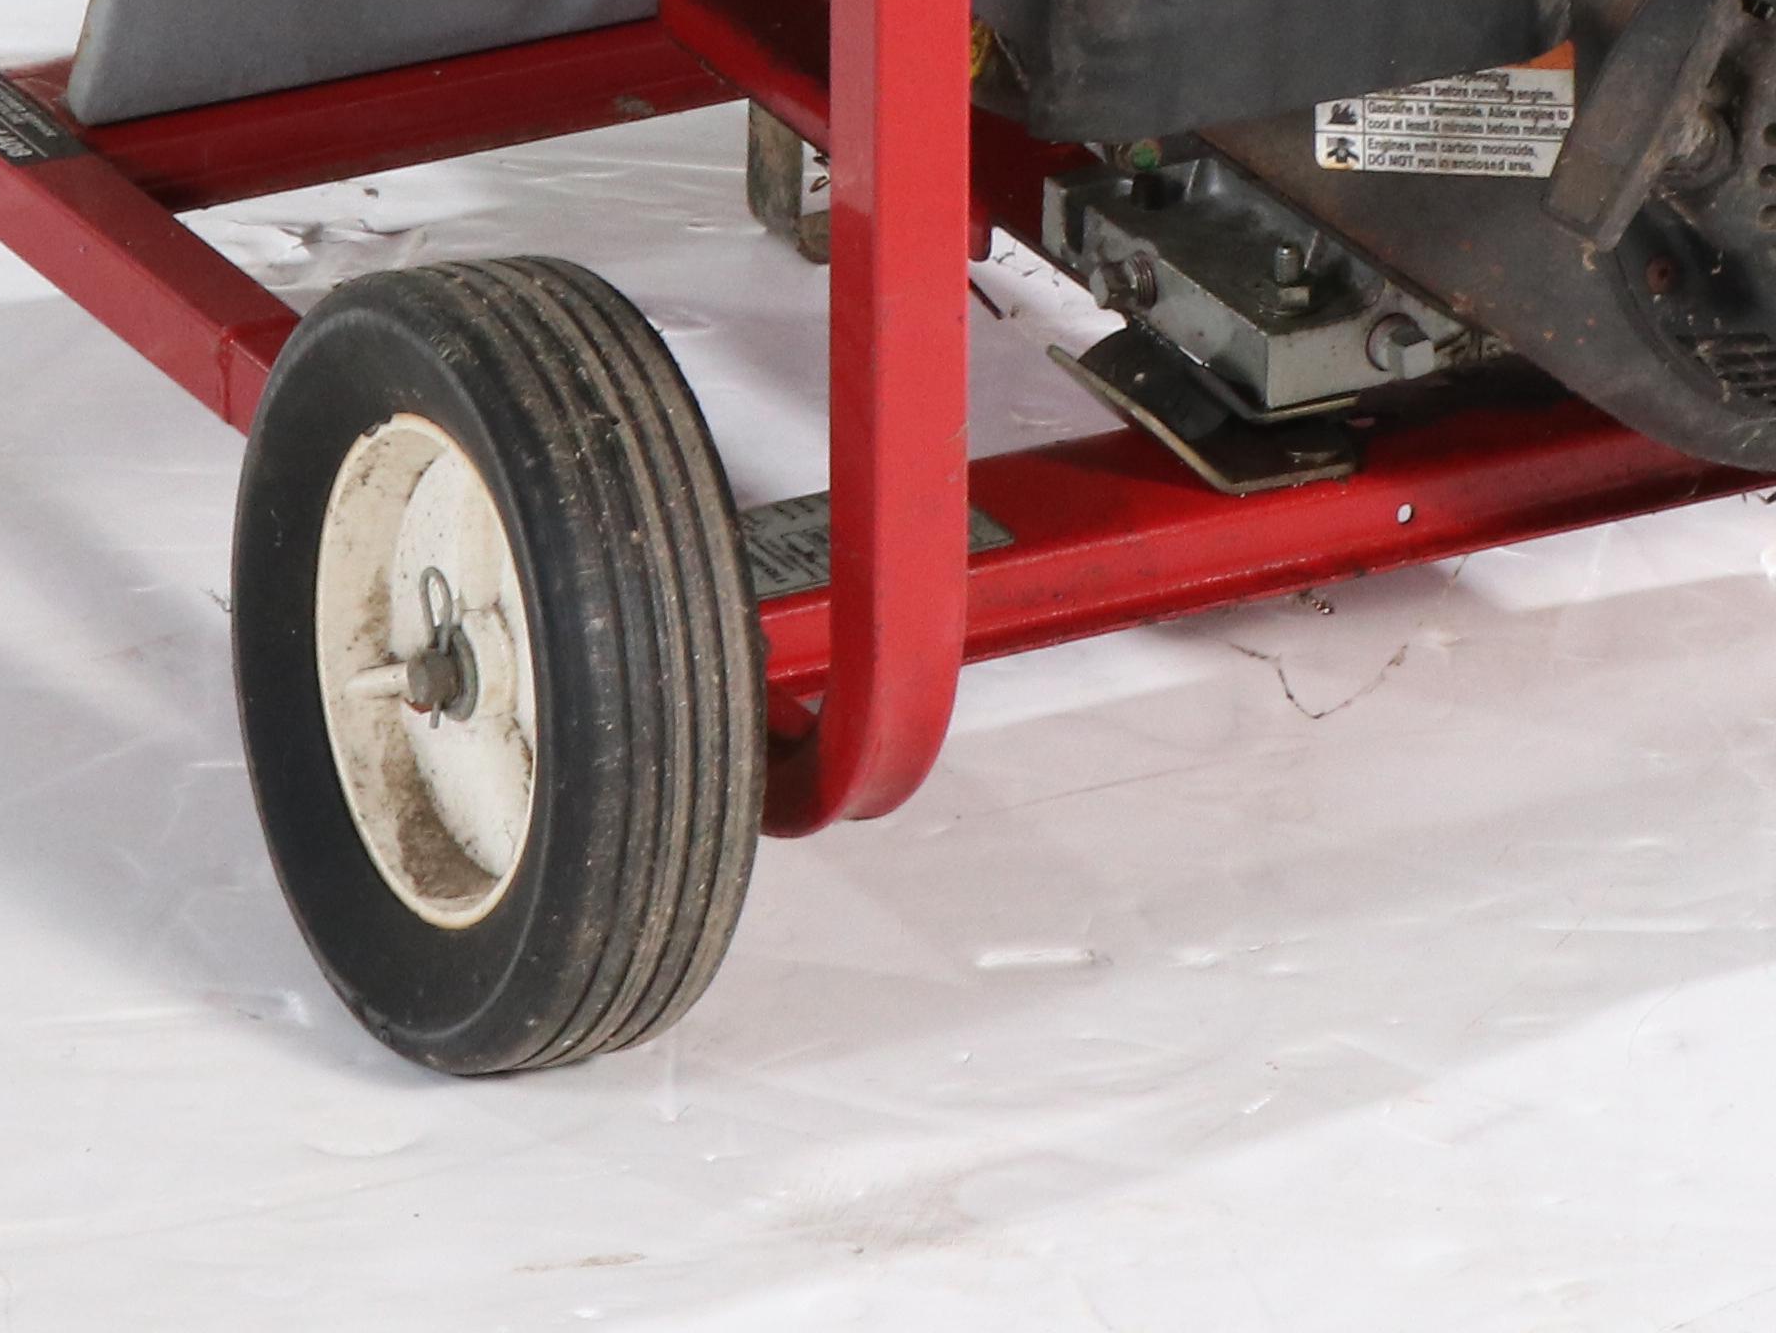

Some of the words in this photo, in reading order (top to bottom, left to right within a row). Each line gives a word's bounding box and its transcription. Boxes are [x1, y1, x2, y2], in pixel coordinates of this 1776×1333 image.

[1367, 101, 1414, 115] Gasoline
[1519, 110, 1555, 126] engine
[1557, 109, 1569, 121] to
[1368, 116, 1391, 130] cool
[1367, 137, 1412, 154] Engines
[1440, 141, 1478, 153] carbon
[1367, 153, 1387, 166] DO
[1388, 153, 1415, 167] NOT
